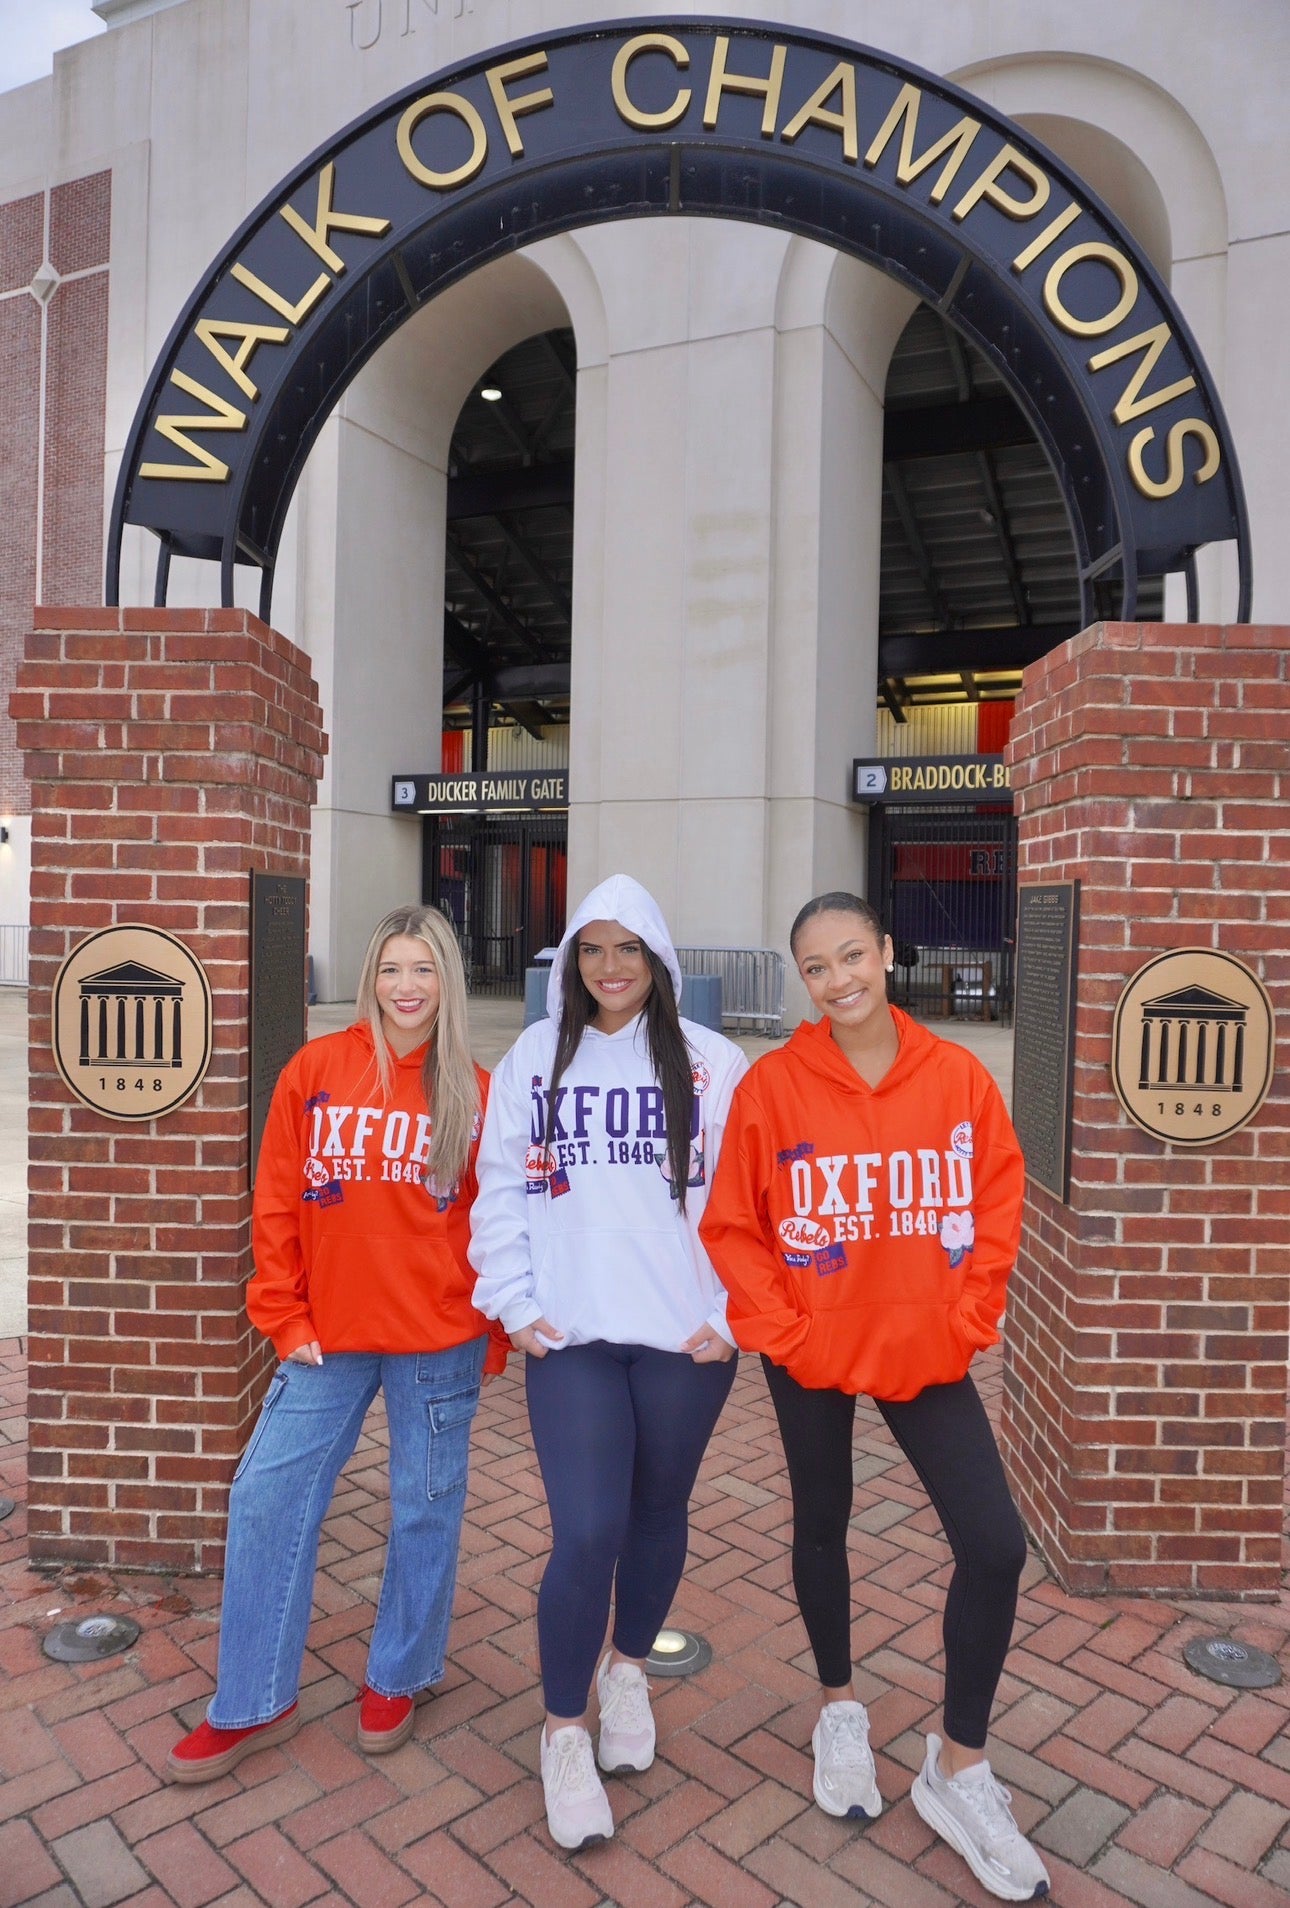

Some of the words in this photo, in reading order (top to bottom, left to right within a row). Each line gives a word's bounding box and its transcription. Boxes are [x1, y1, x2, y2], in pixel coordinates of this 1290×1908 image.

[138, 161, 391, 482] WALK
[396, 51, 553, 189] OF
[611, 33, 1220, 499] CHAMPIONS
[428, 781, 477, 802] DUCKER
[482, 779, 527, 801] FAMILY
[531, 778, 564, 800] GATE
[866, 773, 876, 787] 2
[401, 787, 409, 799] 3
[99, 1078, 162, 1091] 1848
[1158, 1102, 1221, 1116] 1848
[557, 1141, 597, 1167] EST.
[608, 1141, 654, 1165] 1848
[332, 1158, 371, 1181] EST.
[380, 1160, 421, 1185] 1848
[790, 1149, 973, 1217] OXFORD
[781, 1220, 828, 1247] Rebels
[833, 1214, 880, 1243] EST.
[889, 1210, 938, 1237] 1848
[816, 1250, 830, 1262] GO
[819, 1257, 845, 1273] REBS
